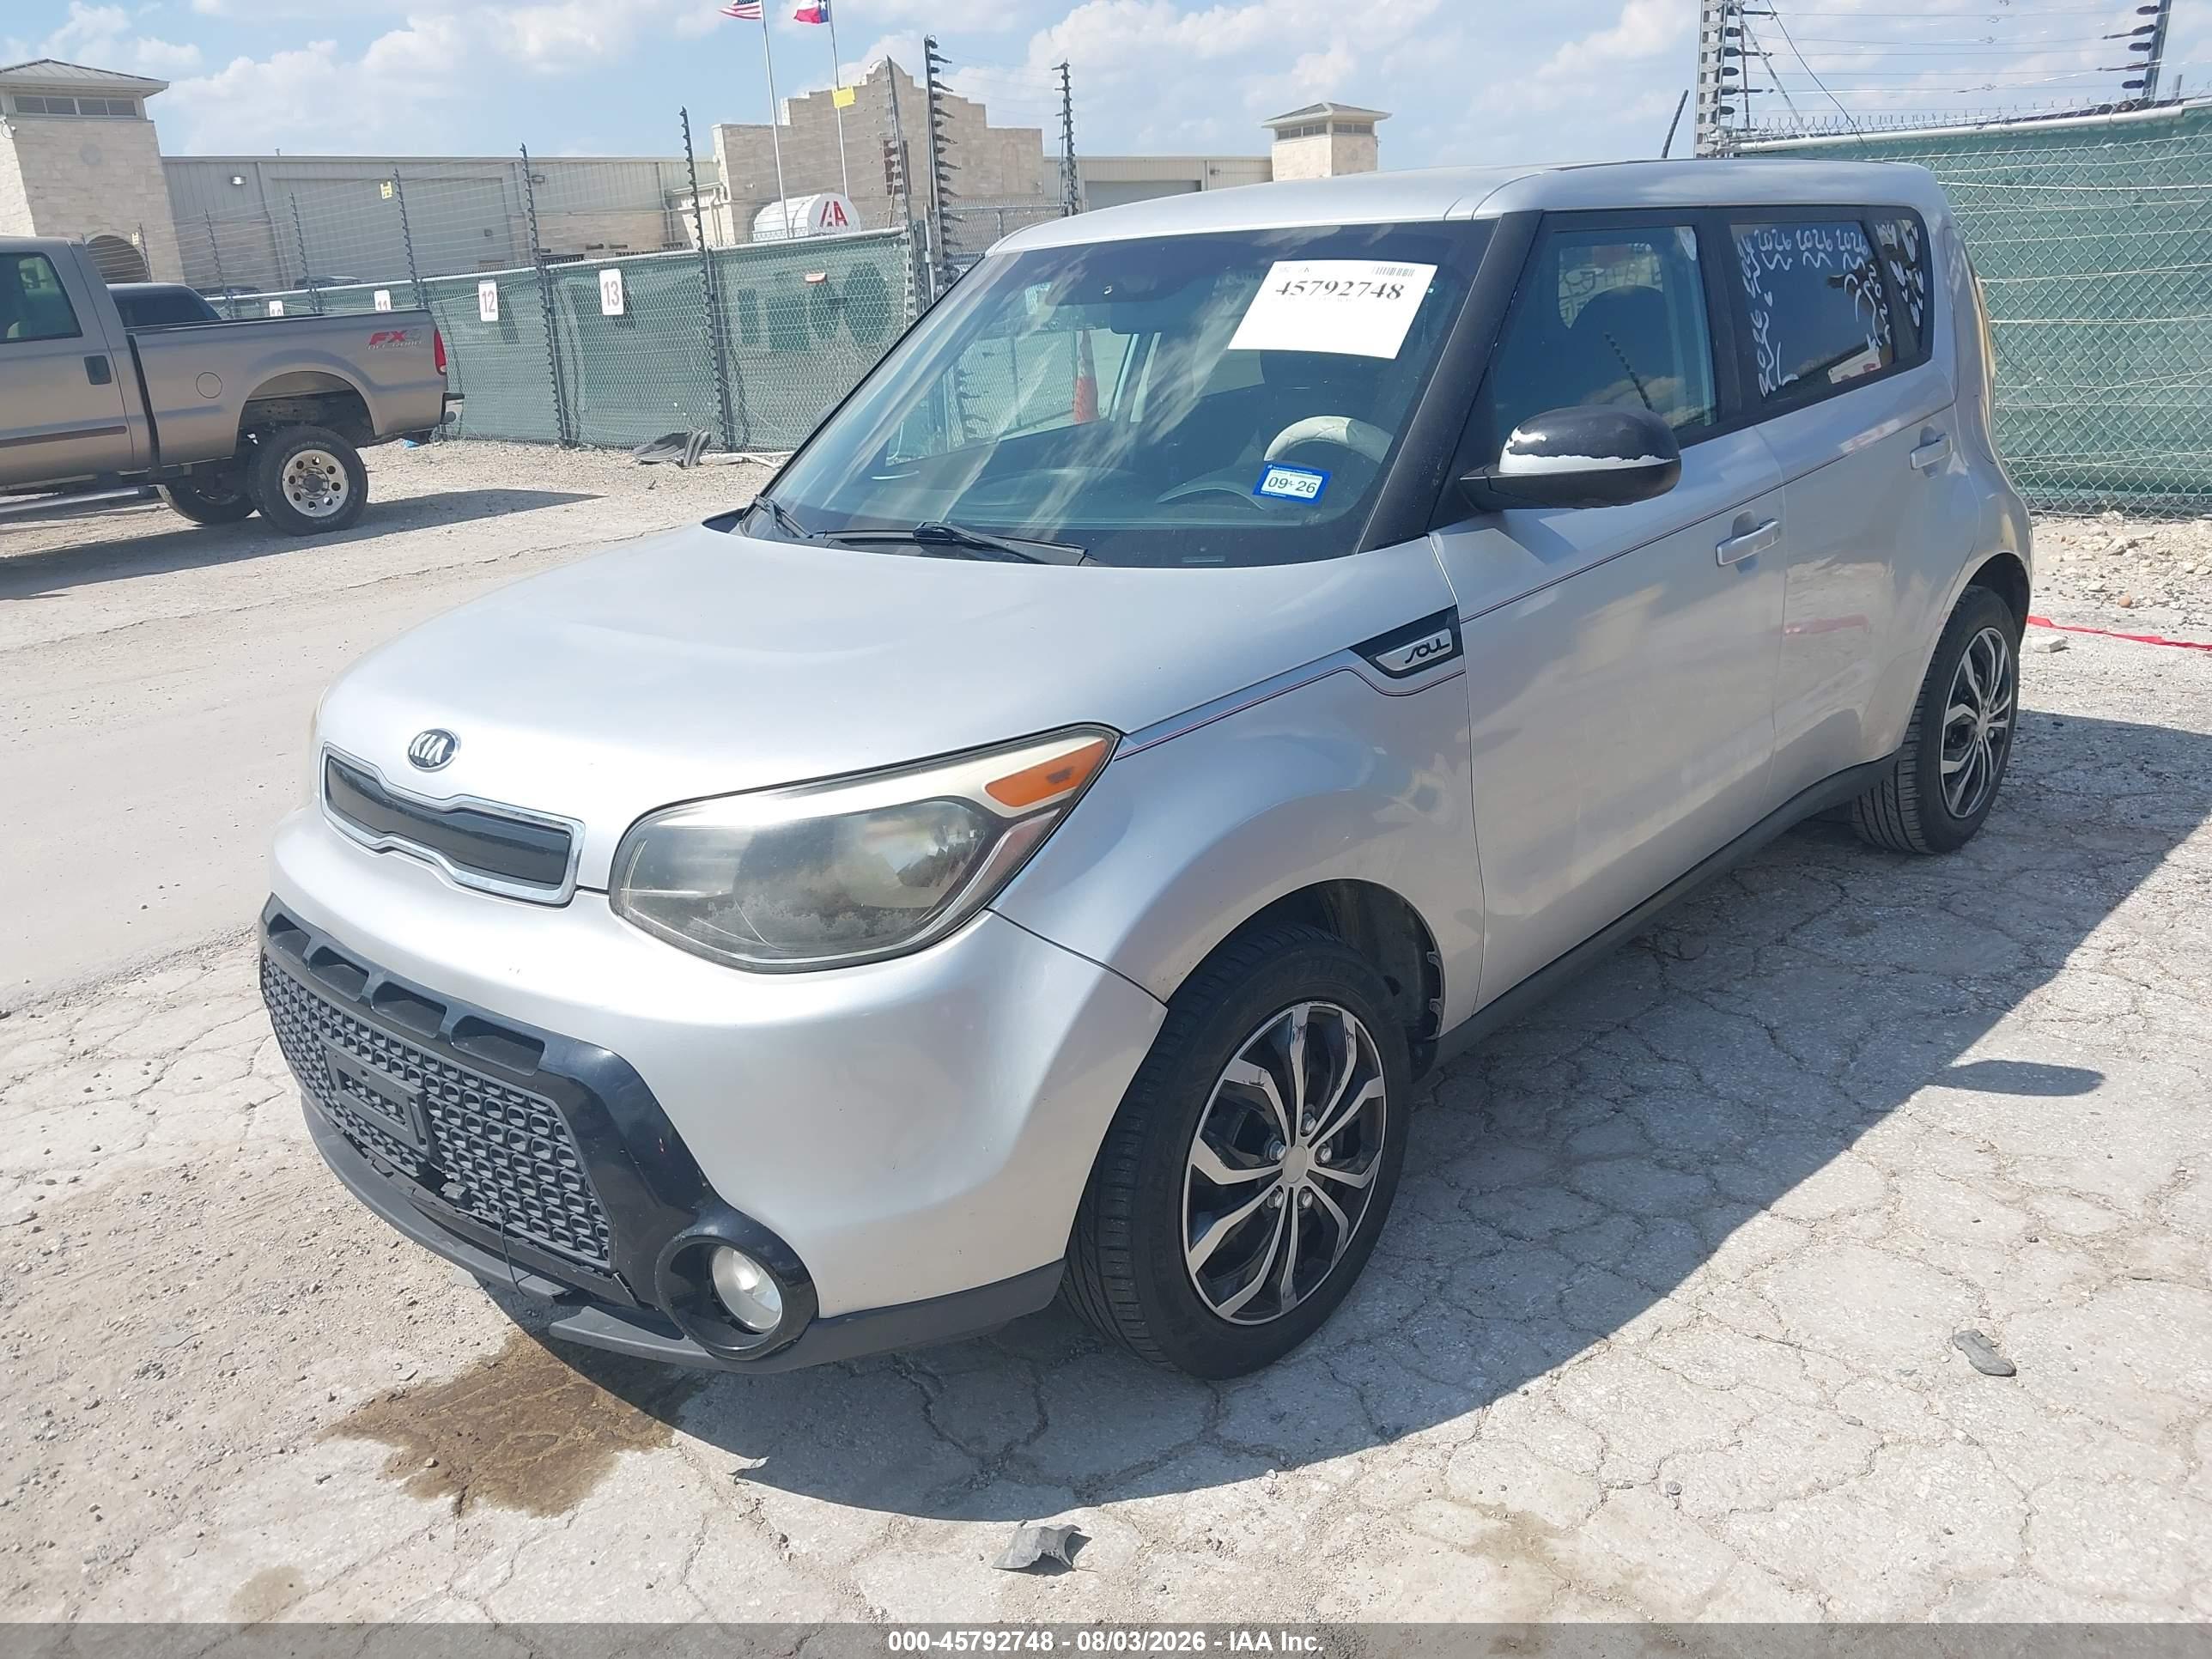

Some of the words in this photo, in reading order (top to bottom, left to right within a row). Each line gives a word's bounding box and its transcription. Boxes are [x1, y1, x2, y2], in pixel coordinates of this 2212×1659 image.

[1754, 228, 1792, 252] 2026
[1796, 228, 1833, 252] 2026
[1836, 228, 1869, 257] 2026
[482, 289, 496, 313] 12
[603, 281, 621, 307] 13
[1275, 279, 1406, 301] 45792748
[1750, 308, 1769, 398] 2026
[1267, 477, 1289, 489] 09
[1295, 480, 1317, 494] 26
[1404, 638, 1450, 665] SOUL
